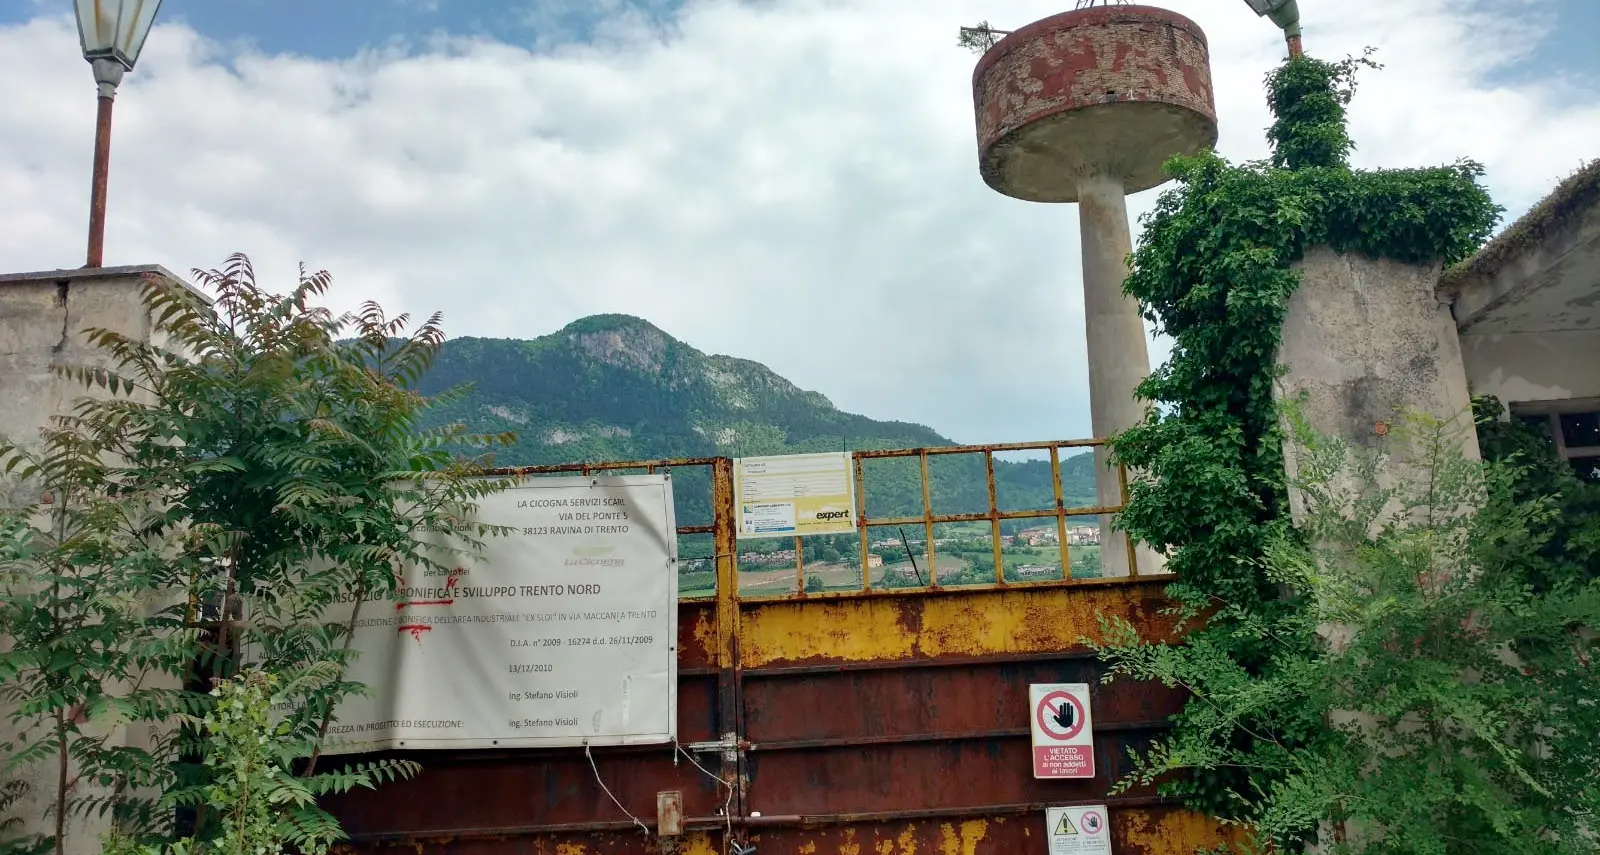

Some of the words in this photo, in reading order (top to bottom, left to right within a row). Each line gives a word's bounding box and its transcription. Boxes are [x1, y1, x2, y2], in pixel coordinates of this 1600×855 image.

[517, 500, 528, 508] LA
[530, 499, 568, 508] CICOGNA
[570, 498, 601, 507] SERVIZI
[602, 498, 626, 506] SCARL
[559, 512, 573, 520] VIA
[575, 512, 590, 520] DEL
[592, 512, 621, 520] PONTE
[623, 512, 628, 520] 5
[816, 509, 849, 521] expert
[522, 526, 548, 535] 38123
[550, 526, 582, 535] RAVINA
[584, 526, 593, 534] DI
[594, 525, 629, 533] TRENTO
[578, 558, 625, 567] Cicogna
[424, 570, 436, 578] per
[400, 587, 451, 598] BONIFICA
[454, 587, 460, 598] E
[462, 585, 517, 598] SVILUPPO
[519, 584, 564, 596] TRENTO
[567, 584, 601, 595] NORD
[558, 613, 567, 621] IN
[569, 613, 581, 621] VIA
[628, 610, 657, 619] TRENTO
[510, 639, 531, 647] D.I.A.
[542, 638, 561, 646] 2009
[568, 637, 591, 646] 16274
[592, 636, 607, 645] d.d.
[609, 635, 654, 645] 26/11/2009
[508, 664, 553, 673] 13/12/2010
[524, 691, 553, 700] Stefano
[555, 690, 578, 699] Visioli
[356, 724, 364, 732] IN
[366, 720, 400, 731] PROGETTO
[401, 720, 412, 728] ED
[413, 720, 464, 728] ESECUZIONE:
[524, 718, 553, 727] Stefano
[555, 717, 578, 726] Visioli
[1049, 747, 1078, 755] VIETATO
